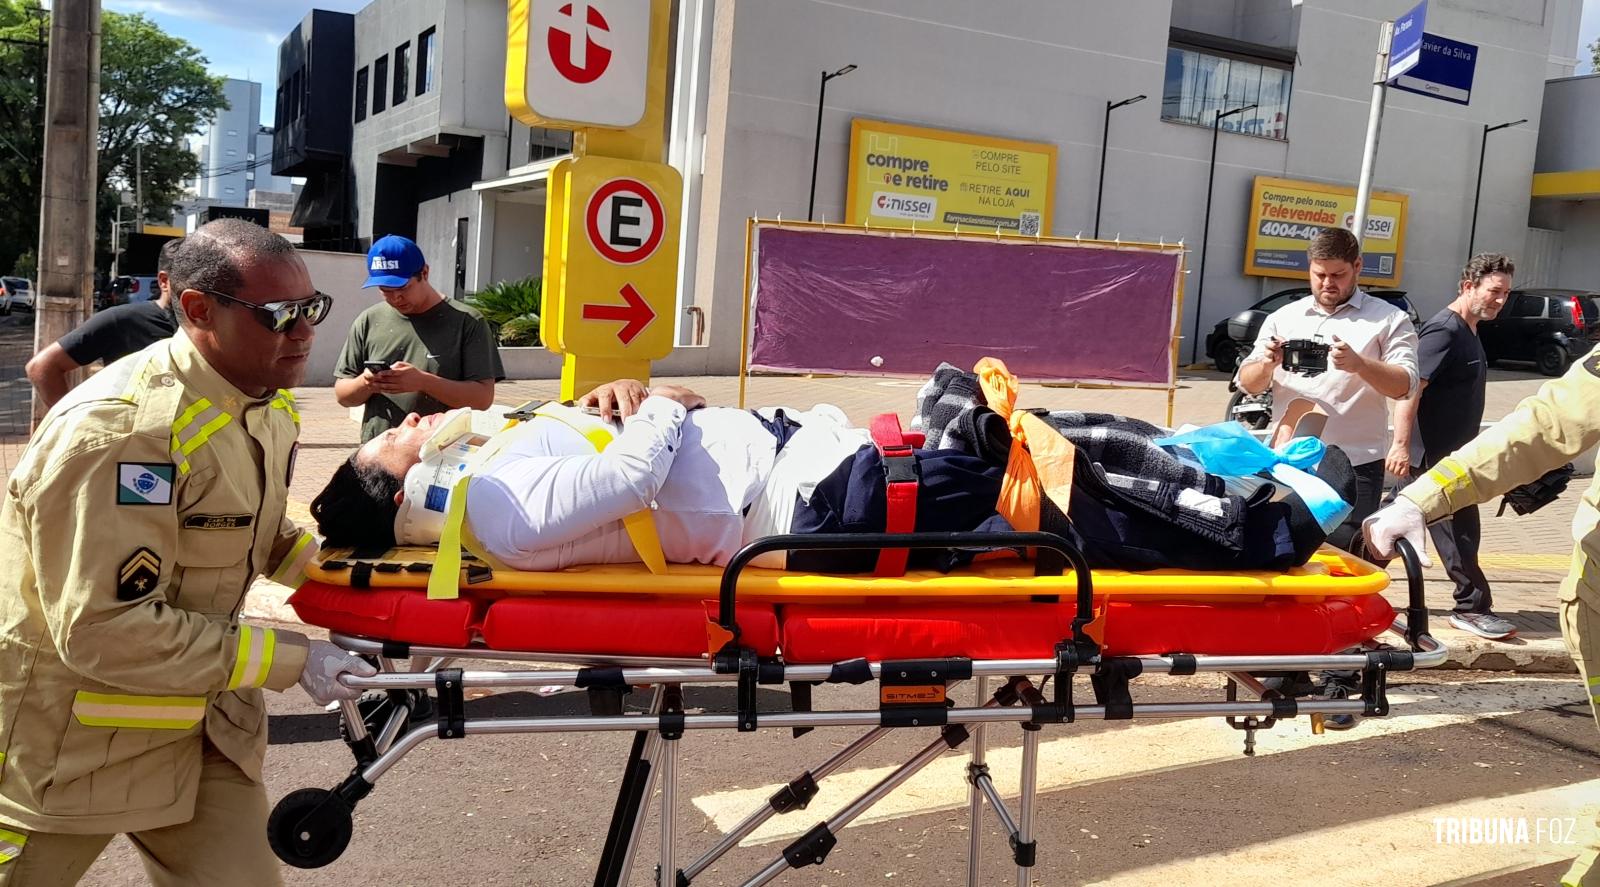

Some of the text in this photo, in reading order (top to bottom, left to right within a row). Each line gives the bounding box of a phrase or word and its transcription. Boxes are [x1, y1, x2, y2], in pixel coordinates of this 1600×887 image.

[1421, 38, 1442, 53] avier
[1442, 45, 1451, 56] da
[1453, 47, 1471, 61] Silva
[866, 153, 929, 172] compre
[980, 151, 1019, 163] COMPRE
[975, 161, 1021, 175] PELO SITE
[892, 174, 949, 191] e retire
[969, 183, 1030, 198] RETIRE AQUI
[978, 196, 1015, 208] NA LOJA
[1262, 191, 1338, 209] Compre pelo nosso
[610, 195, 643, 247] E
[1262, 203, 1336, 224] Televendas
[1262, 222, 1318, 240] 4004-40
[371, 260, 399, 270] ARISI
